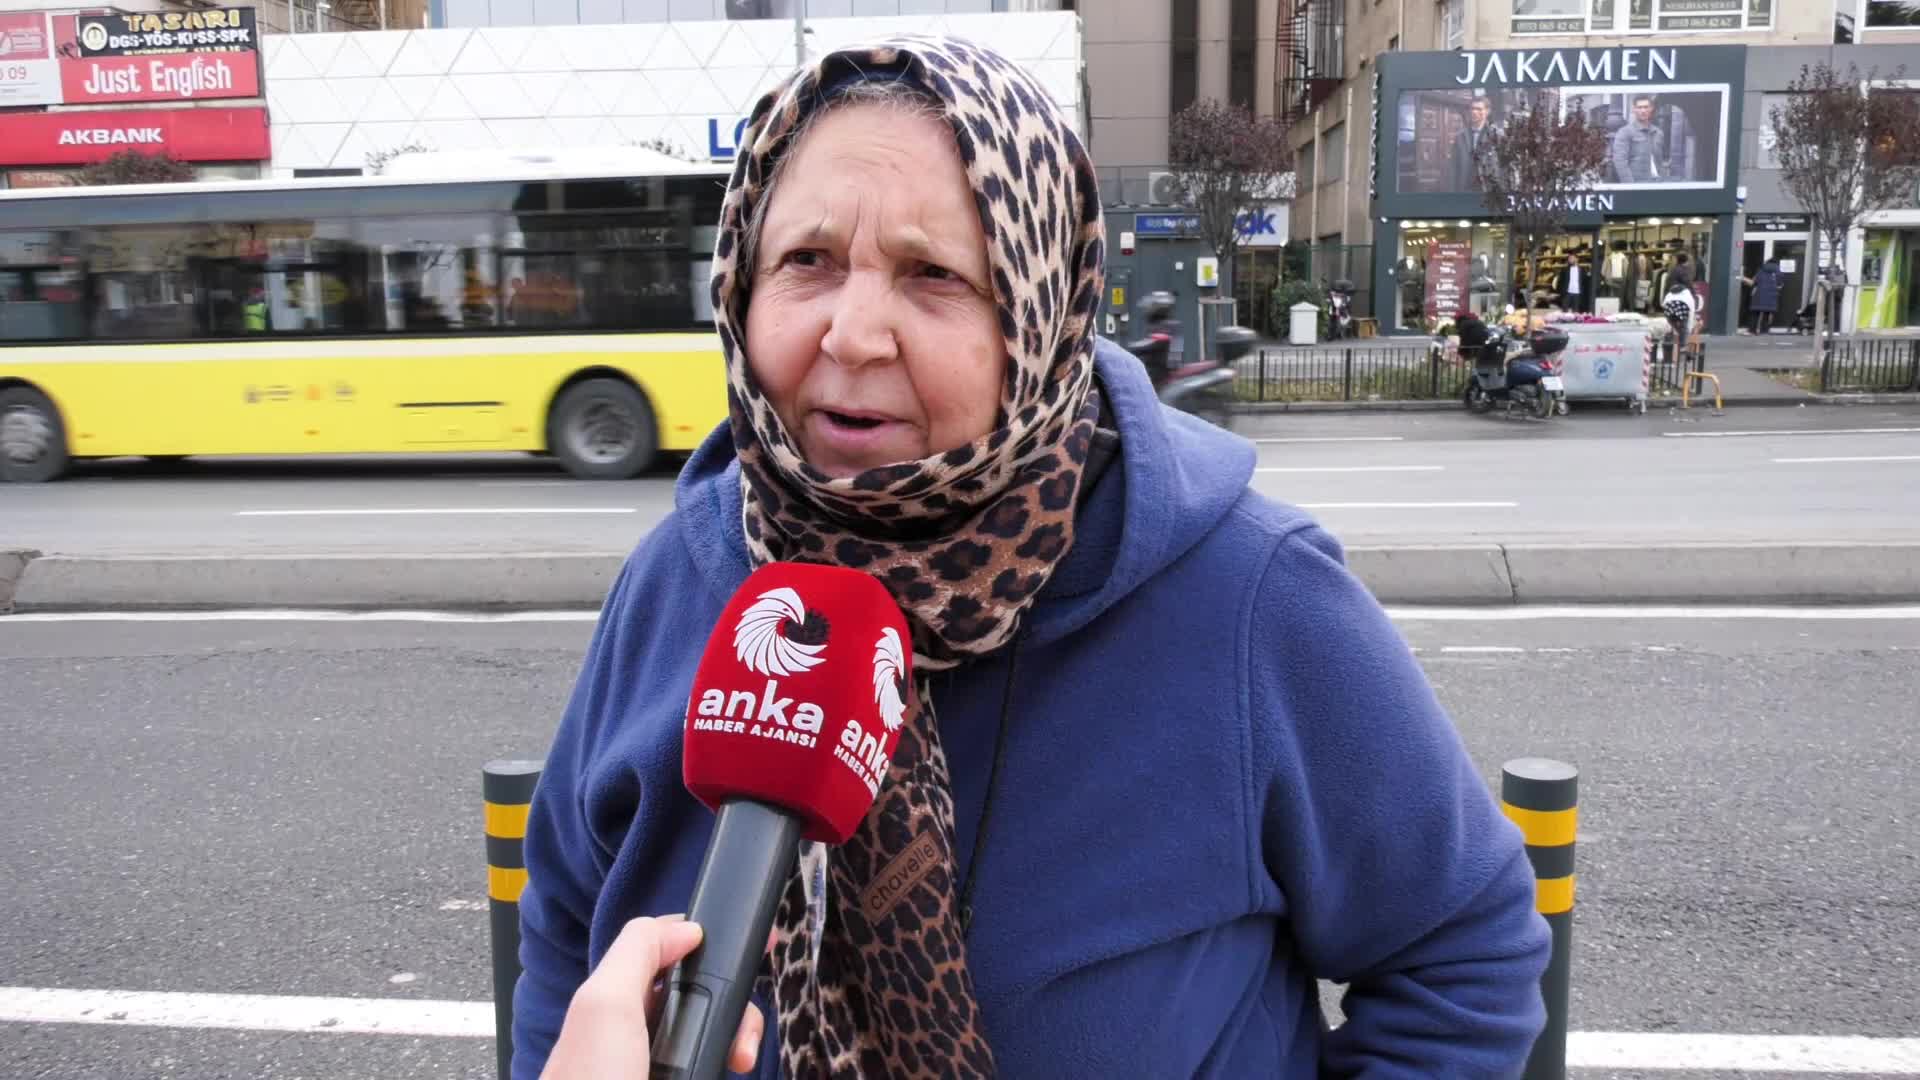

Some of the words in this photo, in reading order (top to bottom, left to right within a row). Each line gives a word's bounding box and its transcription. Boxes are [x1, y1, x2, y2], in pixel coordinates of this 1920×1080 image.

[122, 9, 240, 32] TASARI
[85, 63, 142, 95] Just
[151, 58, 232, 97] English
[1456, 49, 1677, 84] JAKAMEN
[58, 128, 164, 145] AKBANK
[698, 680, 824, 734] anka
[693, 719, 745, 734] HABER
[750, 724, 817, 748] AJANSI
[833, 745, 865, 778] HABER
[871, 844, 934, 910] chavelle
